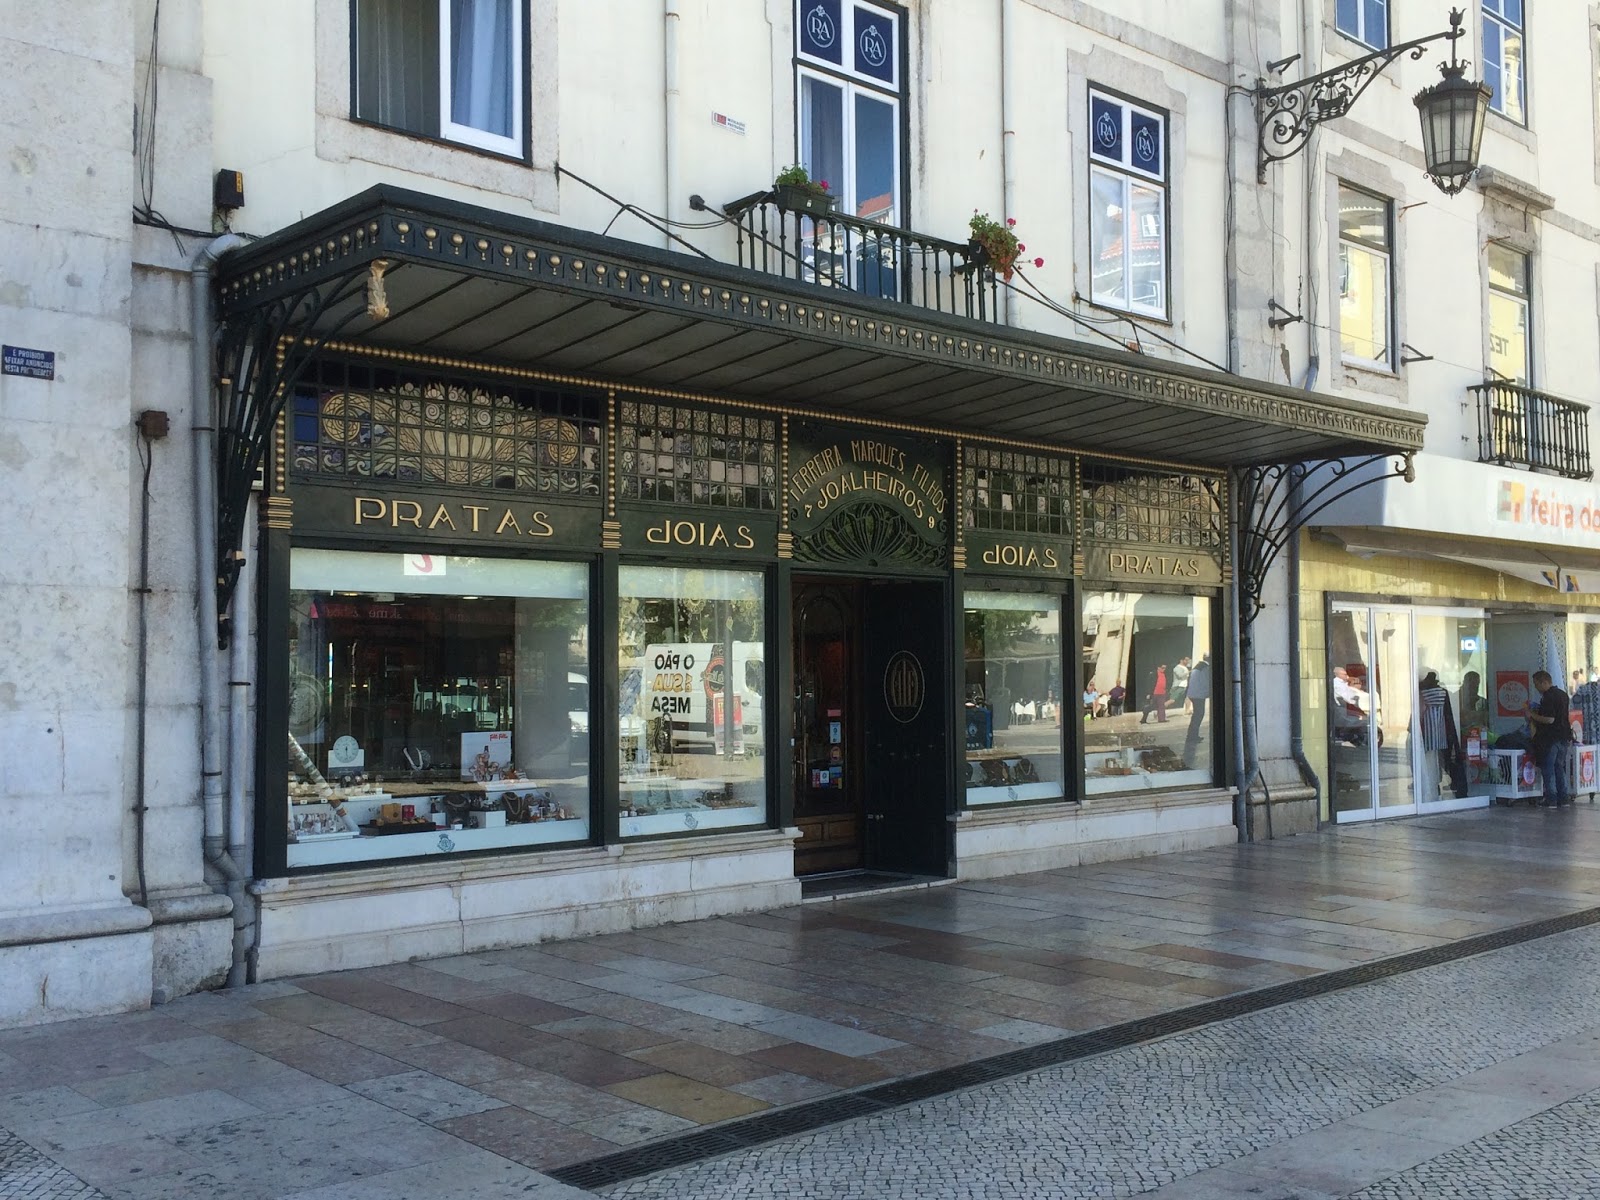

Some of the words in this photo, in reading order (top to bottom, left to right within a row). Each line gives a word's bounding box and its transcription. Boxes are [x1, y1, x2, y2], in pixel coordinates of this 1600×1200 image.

[18, 350, 45, 360] PROIBIDO
[817, 470, 926, 519] JOALHEIROS
[912, 463, 948, 514] FILHOS
[354, 497, 554, 537] PRATAS
[804, 504, 813, 518] 7
[928, 516, 935, 529] 9
[1530, 488, 1574, 529] feira
[1108, 553, 1200, 577] PRATAS
